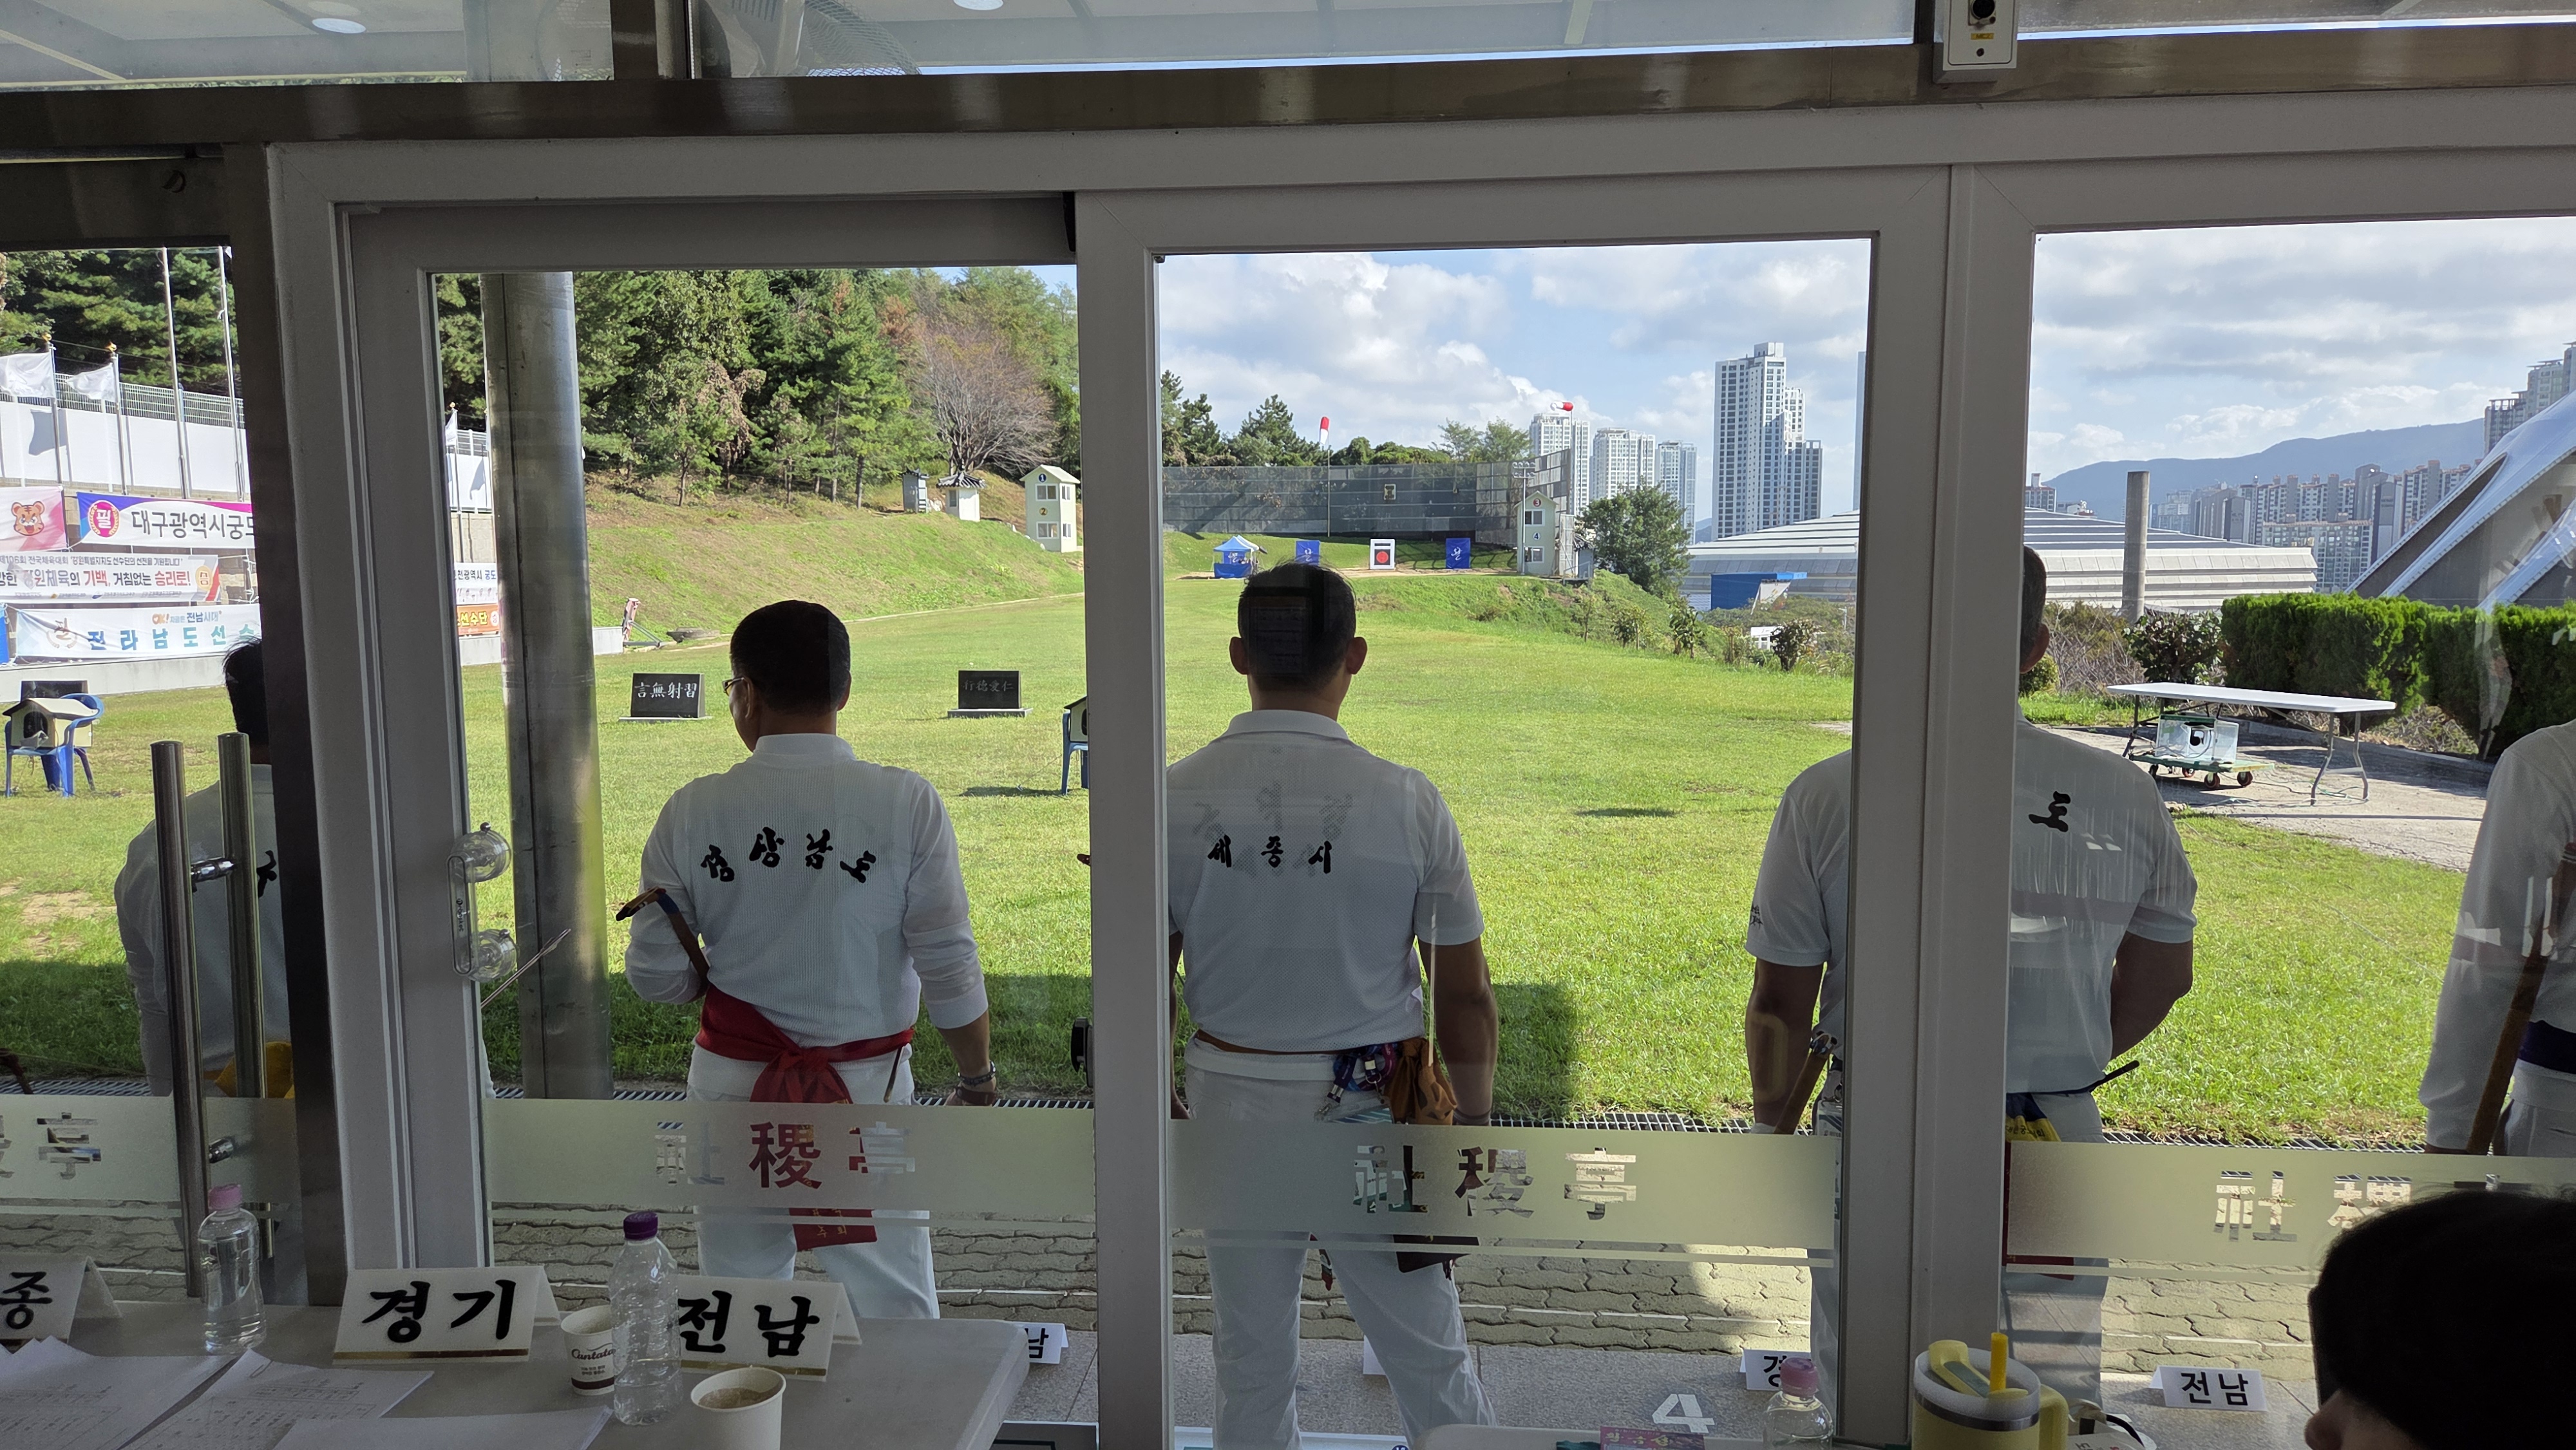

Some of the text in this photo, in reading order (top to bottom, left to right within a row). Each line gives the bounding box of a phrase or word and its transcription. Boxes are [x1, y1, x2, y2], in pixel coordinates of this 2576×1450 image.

[97, 509, 112, 529] 필
[28, 556, 69, 565] 전국체육대회
[83, 570, 111, 587] 기백,
[113, 572, 153, 587] 거침없는
[155, 570, 191, 587] 승리로!
[484, 570, 497, 580] 궁도
[457, 610, 488, 626] 선수단
[2029, 791, 2072, 833] 도
[701, 827, 876, 883] 경상남도
[1208, 834, 1332, 874] 세종시
[361, 1279, 516, 1343] 경기
[677, 1290, 820, 1358] 전남
[2181, 1370, 2249, 1406] 전남
[1652, 1393, 1716, 1434] 4
